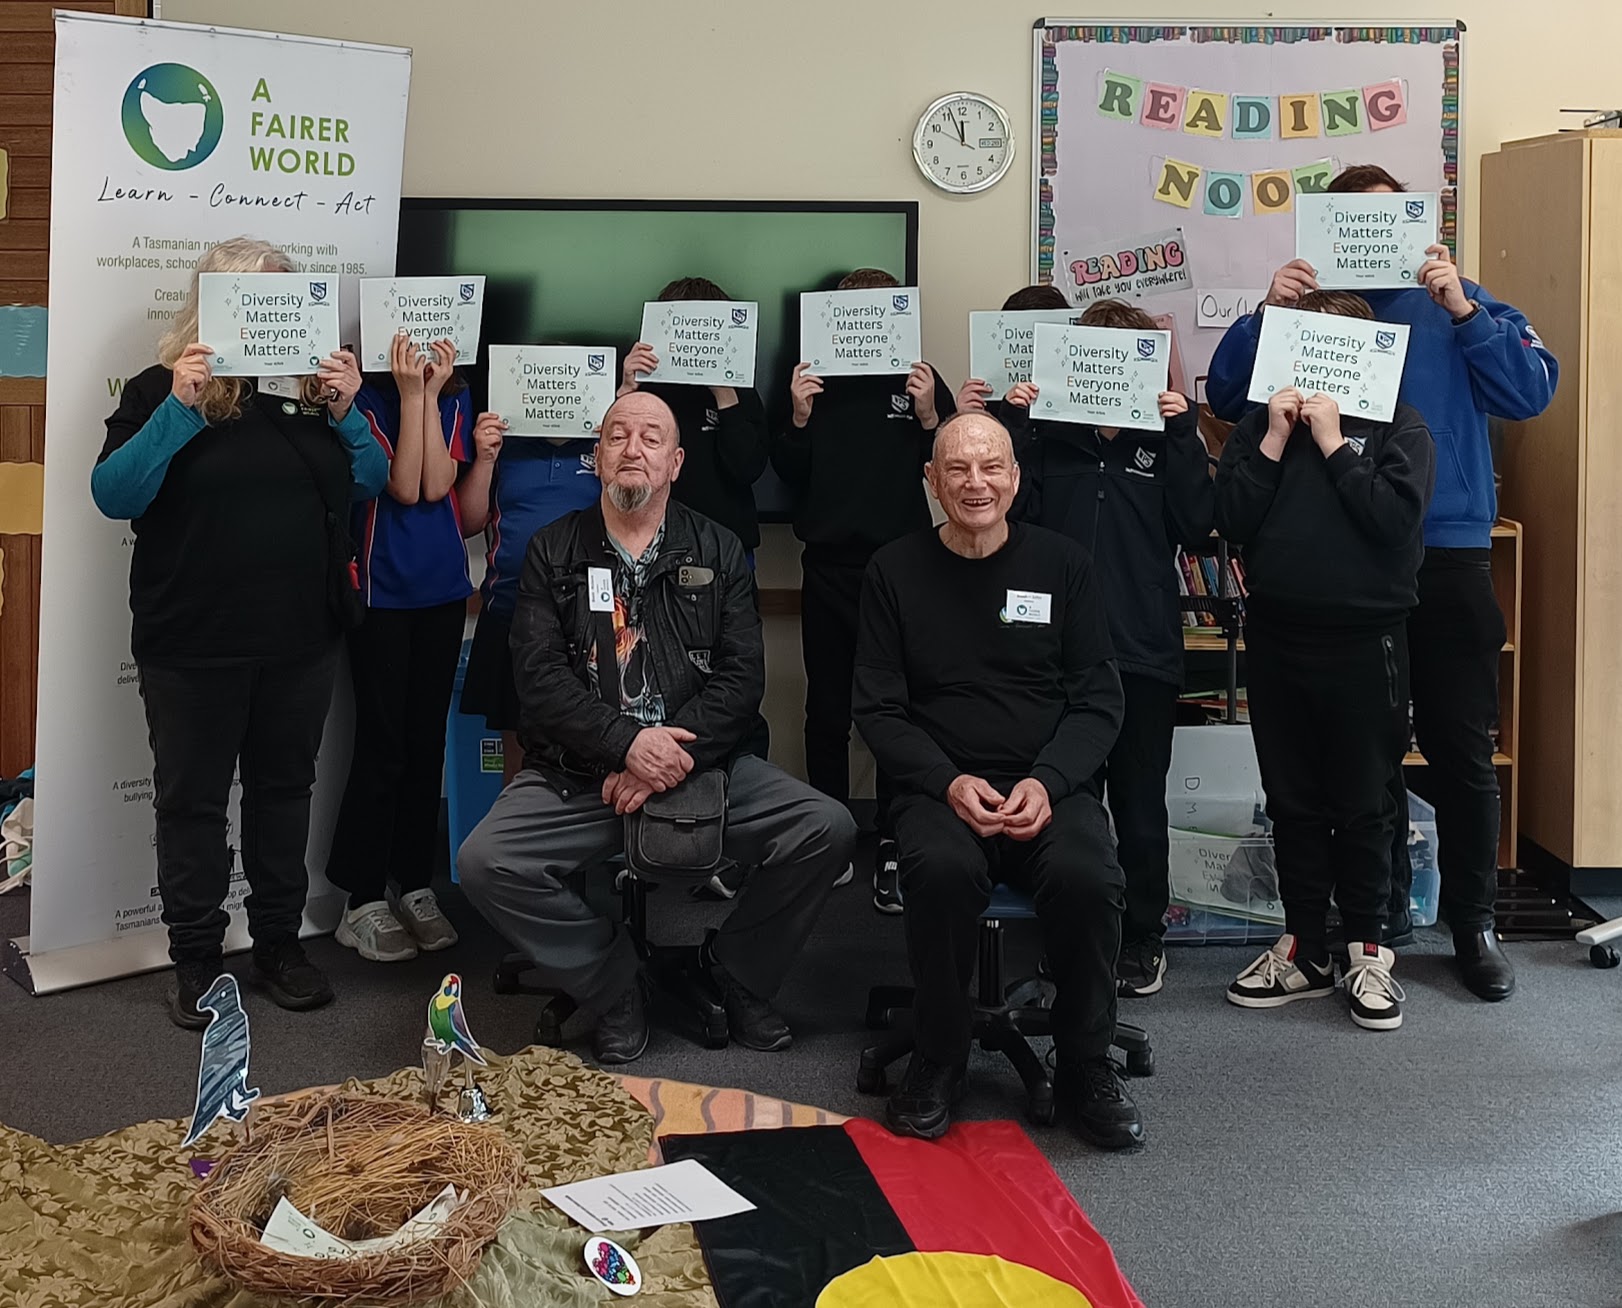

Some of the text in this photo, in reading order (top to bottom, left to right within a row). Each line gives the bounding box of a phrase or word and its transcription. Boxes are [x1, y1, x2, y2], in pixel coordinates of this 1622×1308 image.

[251, 77, 272, 103] A
[957, 106, 967, 116] 12
[1099, 77, 1402, 135] READING
[942, 112, 951, 121] 11
[977, 111, 982, 120] 1
[250, 112, 350, 144] FAIRER
[932, 124, 941, 133] 10
[988, 122, 994, 132] 2
[927, 140, 933, 149] 9
[249, 146, 356, 177] WORLD
[933, 156, 939, 165] 8
[988, 154, 994, 163] 4
[945, 167, 951, 176] 7
[960, 171, 967, 180] 6
[976, 166, 983, 175] 5
[97, 176, 174, 203] Learn
[209, 183, 309, 213] Connect
[333, 191, 376, 216] Act
[1334, 210, 1398, 226] Diversity
[1338, 226, 1393, 239] Matters
[132, 236, 141, 249] A
[143, 236, 201, 252] Tasmanian
[316, 243, 339, 257] with
[1332, 241, 1399, 257] Everyone
[97, 255, 163, 270] workplaces,
[310, 262, 338, 274] since
[340, 262, 368, 276] 1985.
[1070, 240, 1185, 287] READING
[1336, 257, 1392, 270] Matters
[241, 292, 304, 309] Diversity
[398, 294, 455, 309] Diversity
[1201, 294, 1232, 318] Our
[246, 310, 302, 324] Matters
[402, 311, 451, 323] Matters
[833, 304, 887, 319] Diversity
[672, 315, 725, 331] Diversity
[836, 320, 884, 332] Matters
[240, 327, 307, 343] Everyone
[398, 325, 454, 340] Everyone
[674, 328, 721, 342] Matters
[831, 333, 889, 347] Everyone
[1004, 327, 1033, 340] Dive
[1300, 329, 1366, 353] Diversity
[243, 343, 300, 357] Matters
[668, 342, 725, 357] Everyone
[834, 347, 883, 360] Matters
[1068, 344, 1129, 363] Diversity
[1301, 345, 1358, 366] Matters
[523, 362, 581, 379] Diversity
[670, 356, 718, 370] Matters
[1072, 360, 1125, 376] Matters
[1293, 360, 1361, 381] Everyone
[526, 378, 577, 391] Matters
[1066, 375, 1130, 392] Everyone
[1294, 376, 1351, 396] Matters
[521, 392, 582, 408] Everyone
[1069, 391, 1122, 408] Matters
[525, 407, 575, 420] Matters
[112, 777, 152, 791] A diversity
[124, 791, 154, 803] bullying
[115, 910, 122, 919] A
[122, 903, 156, 919] powerful
[115, 915, 160, 932] Tasmanians
